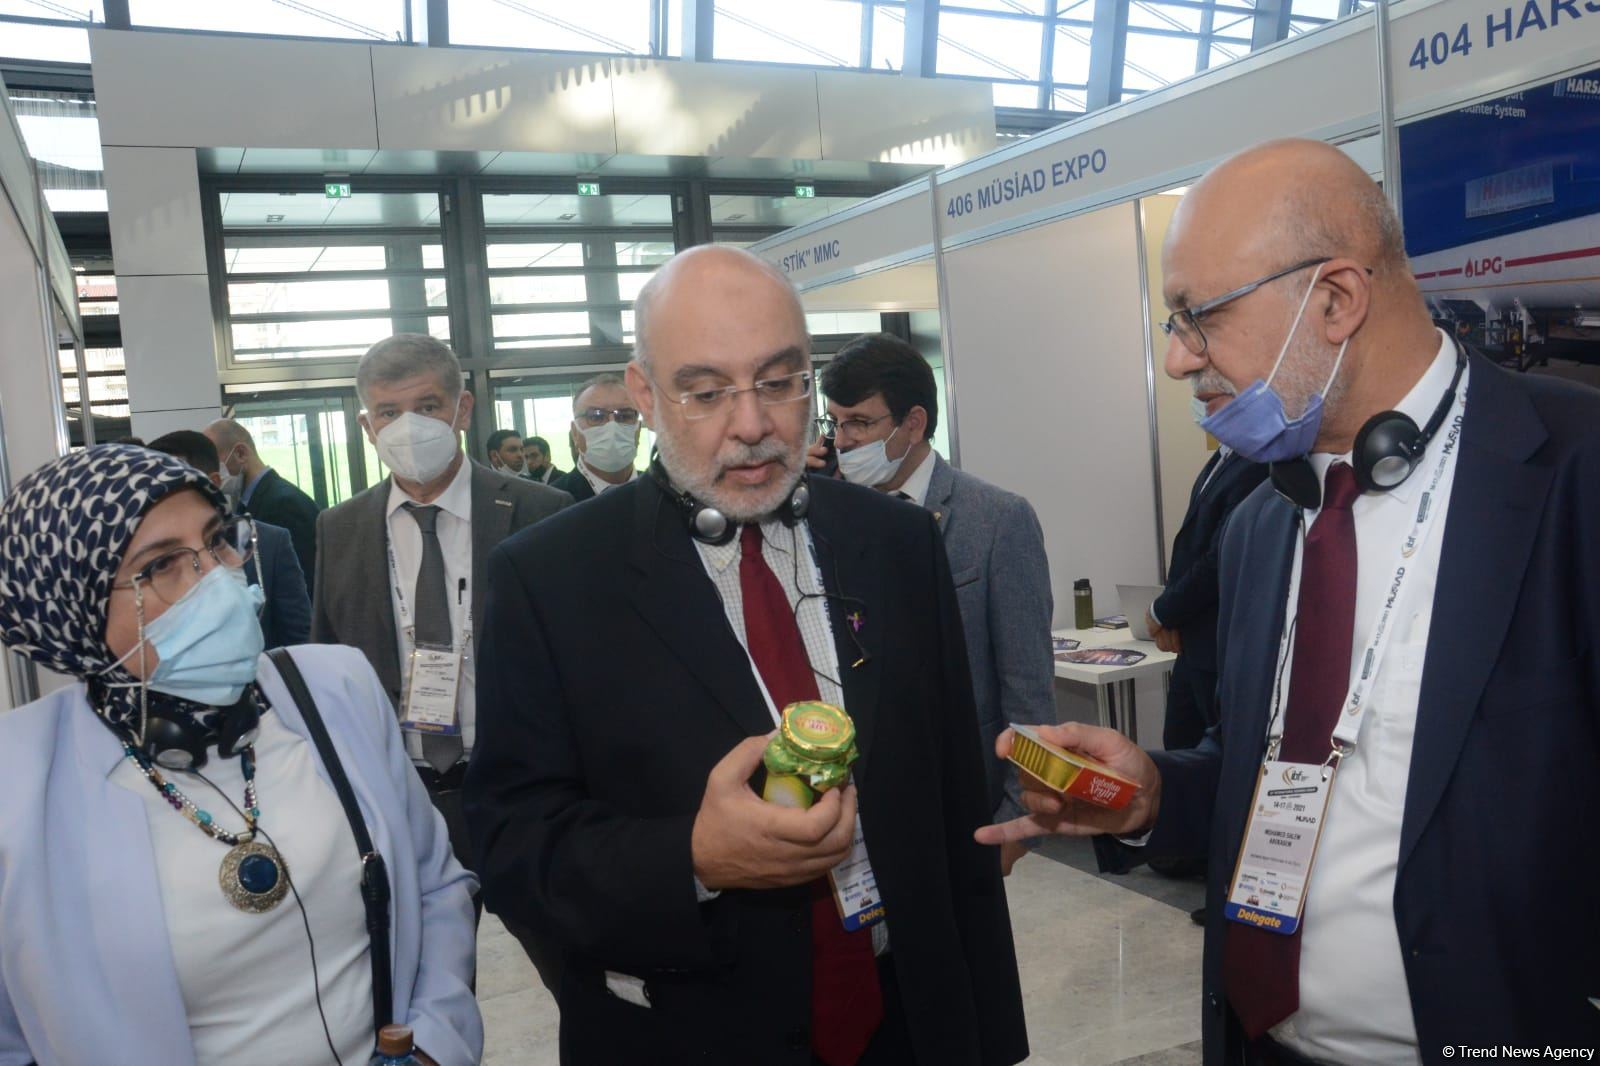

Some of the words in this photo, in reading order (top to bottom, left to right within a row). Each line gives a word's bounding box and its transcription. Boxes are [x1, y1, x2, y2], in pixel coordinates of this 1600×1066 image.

[1409, 23, 1472, 70] 404
[1495, 104, 1526, 119] System
[947, 193, 973, 218] 406
[977, 169, 1046, 210] MÜSİAD
[1052, 148, 1107, 187] EXPO
[814, 239, 840, 265] MMC
[1474, 256, 1502, 276] LPG
[1236, 908, 1282, 928] Delegate
